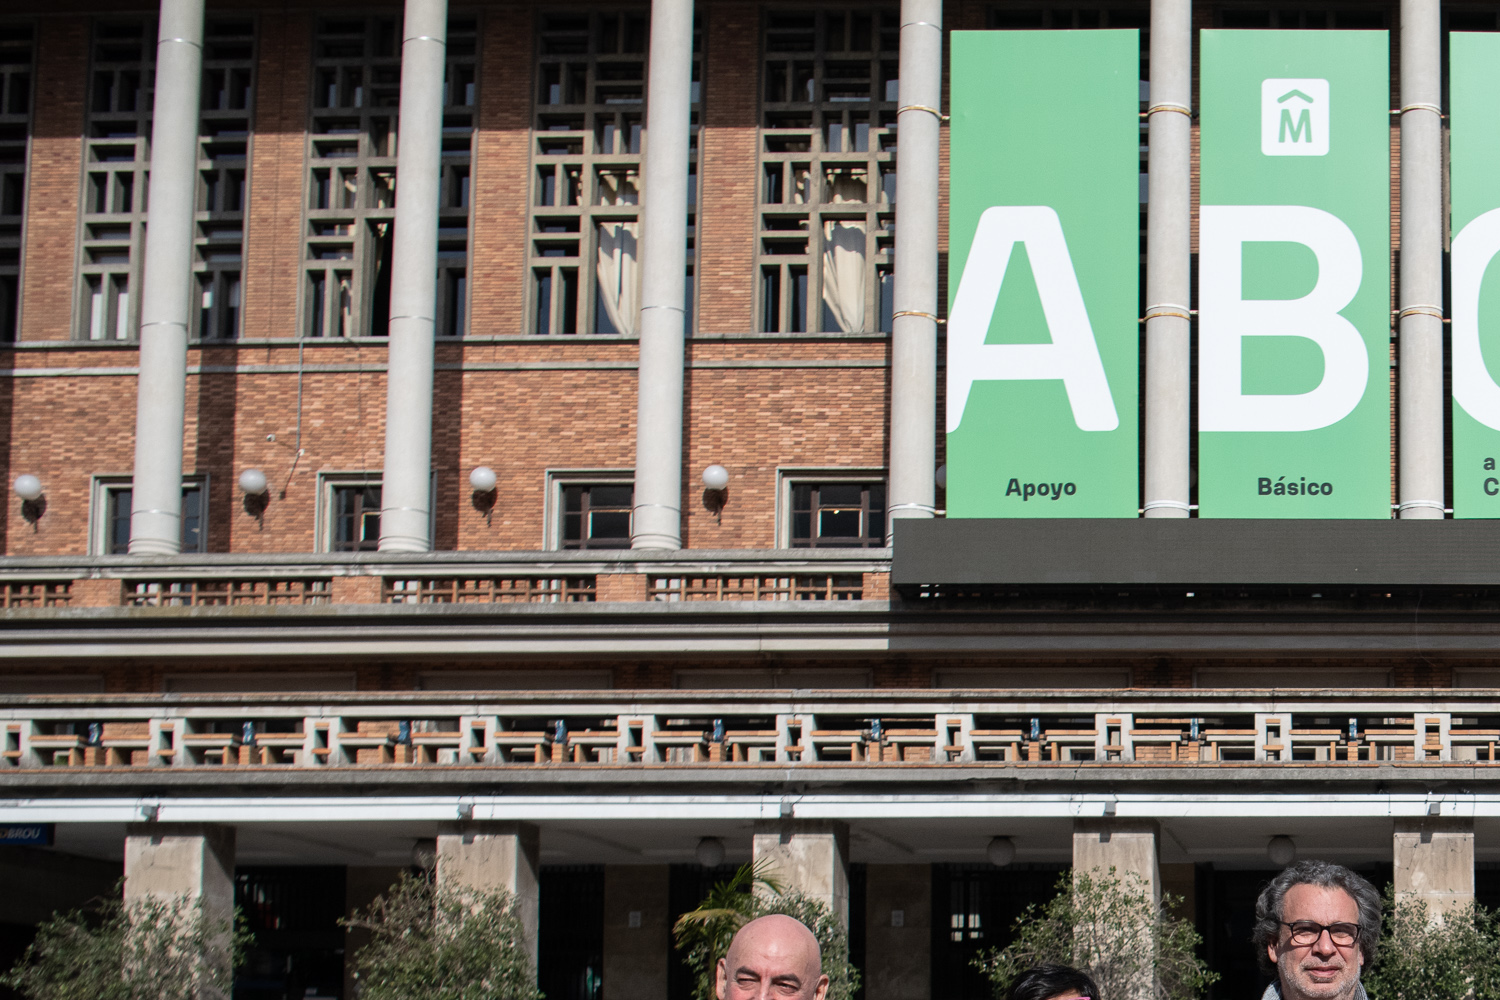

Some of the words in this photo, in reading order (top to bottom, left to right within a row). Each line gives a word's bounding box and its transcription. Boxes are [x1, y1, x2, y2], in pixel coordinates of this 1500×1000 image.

[1278, 109, 1313, 144] M
[946, 205, 1120, 433] A
[1198, 205, 1370, 433] B
[1483, 457, 1497, 471] a
[1005, 476, 1077, 501] Apoyo
[1257, 476, 1334, 497] Básico
